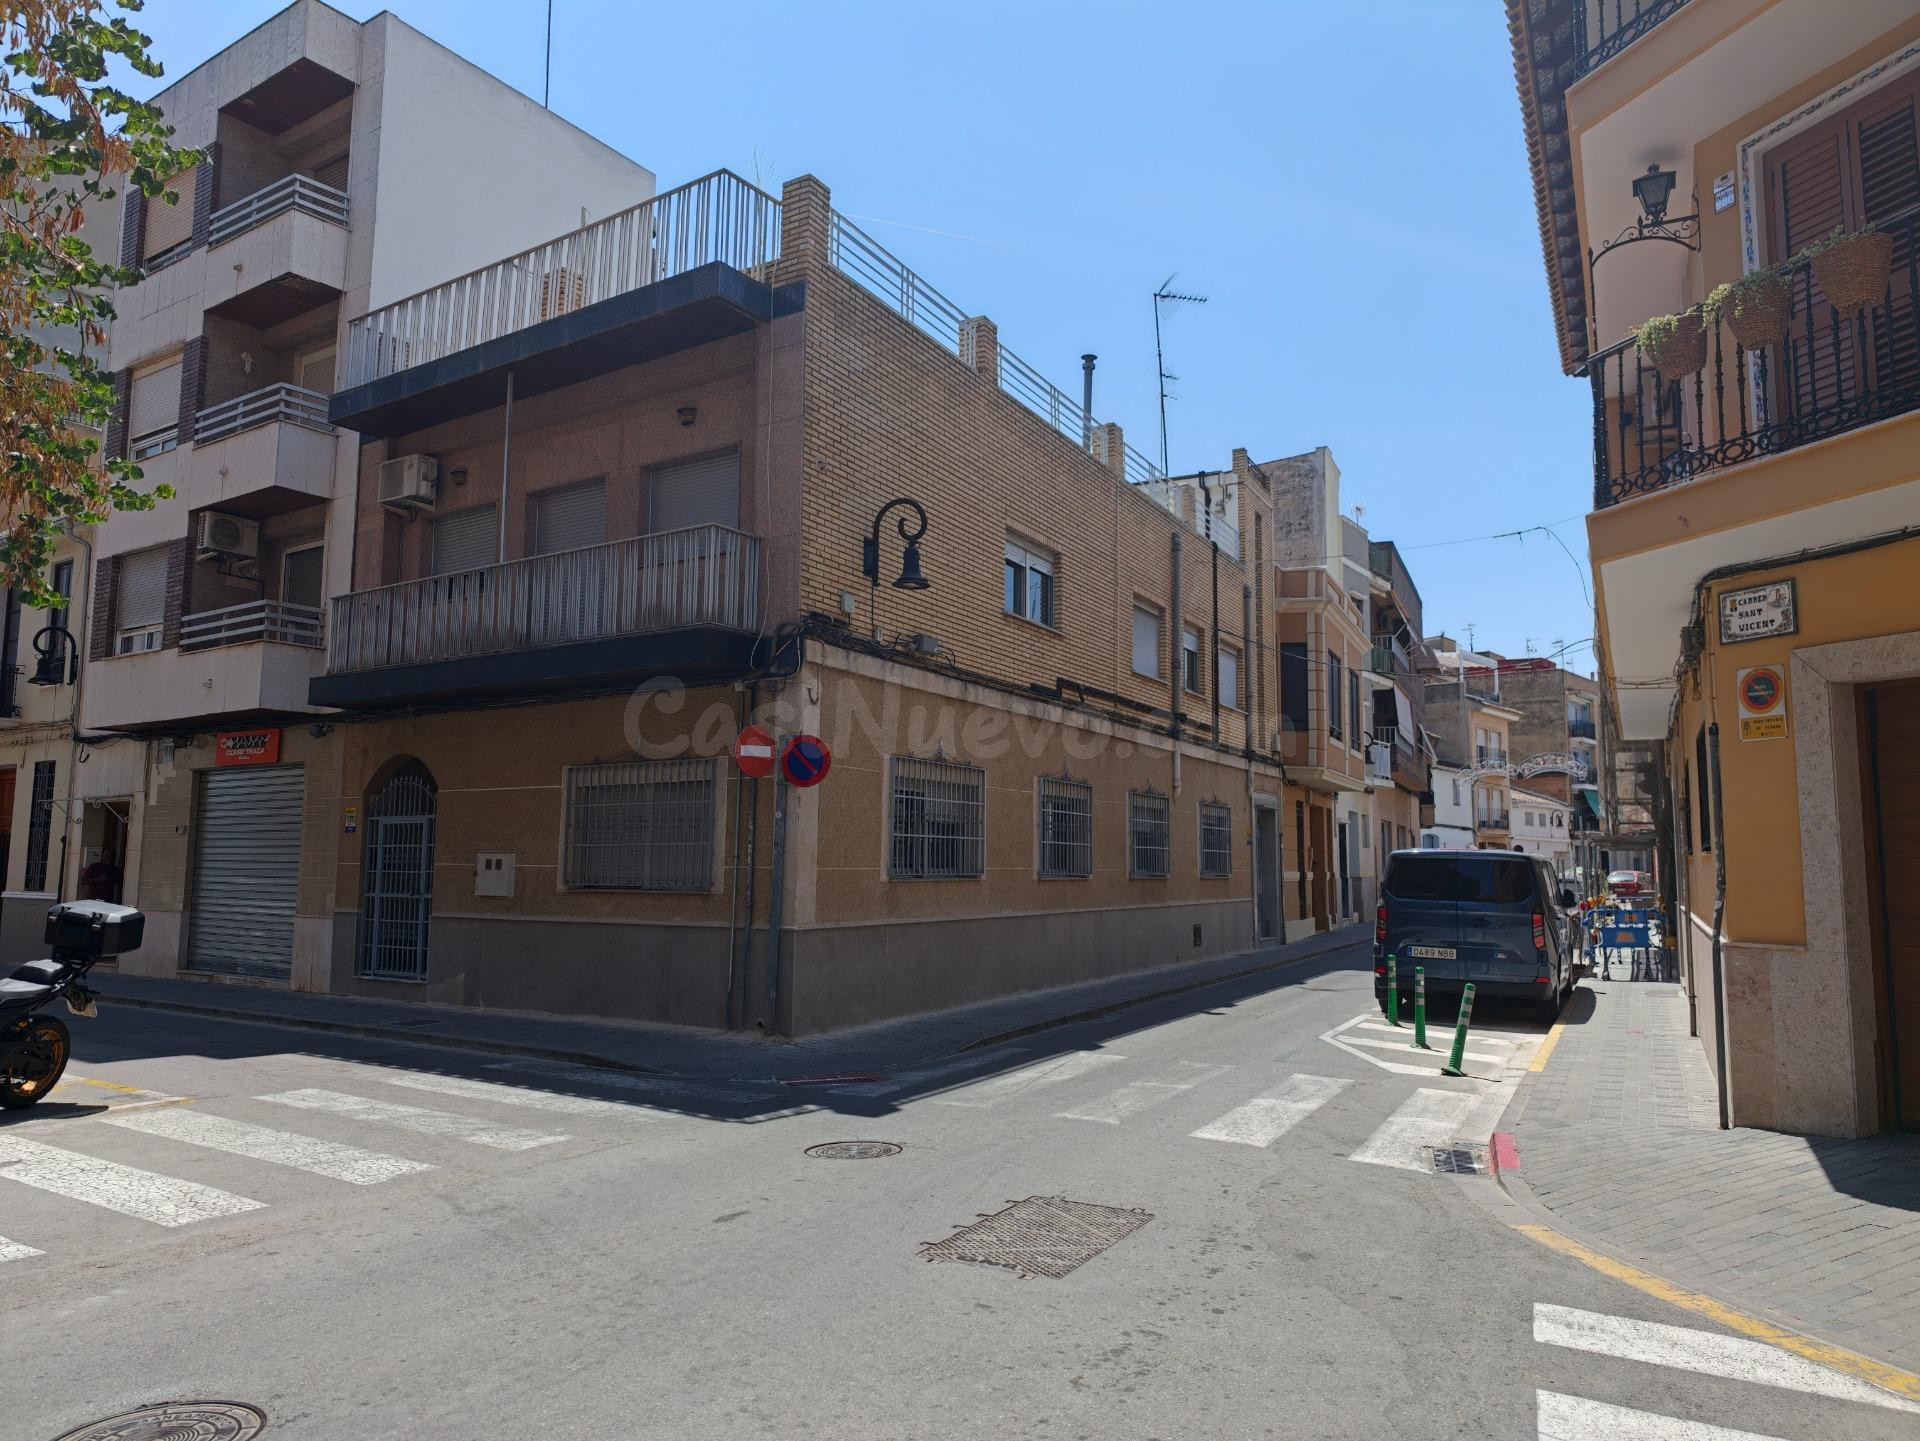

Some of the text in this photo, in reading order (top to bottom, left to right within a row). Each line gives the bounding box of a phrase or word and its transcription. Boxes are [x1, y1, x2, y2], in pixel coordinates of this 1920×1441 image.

[1738, 595, 1768, 606] CARRER
[1738, 608, 1763, 619] SANT
[1738, 619, 1776, 632] VICENT
[1413, 948, 1454, 958] 0489 NBB
